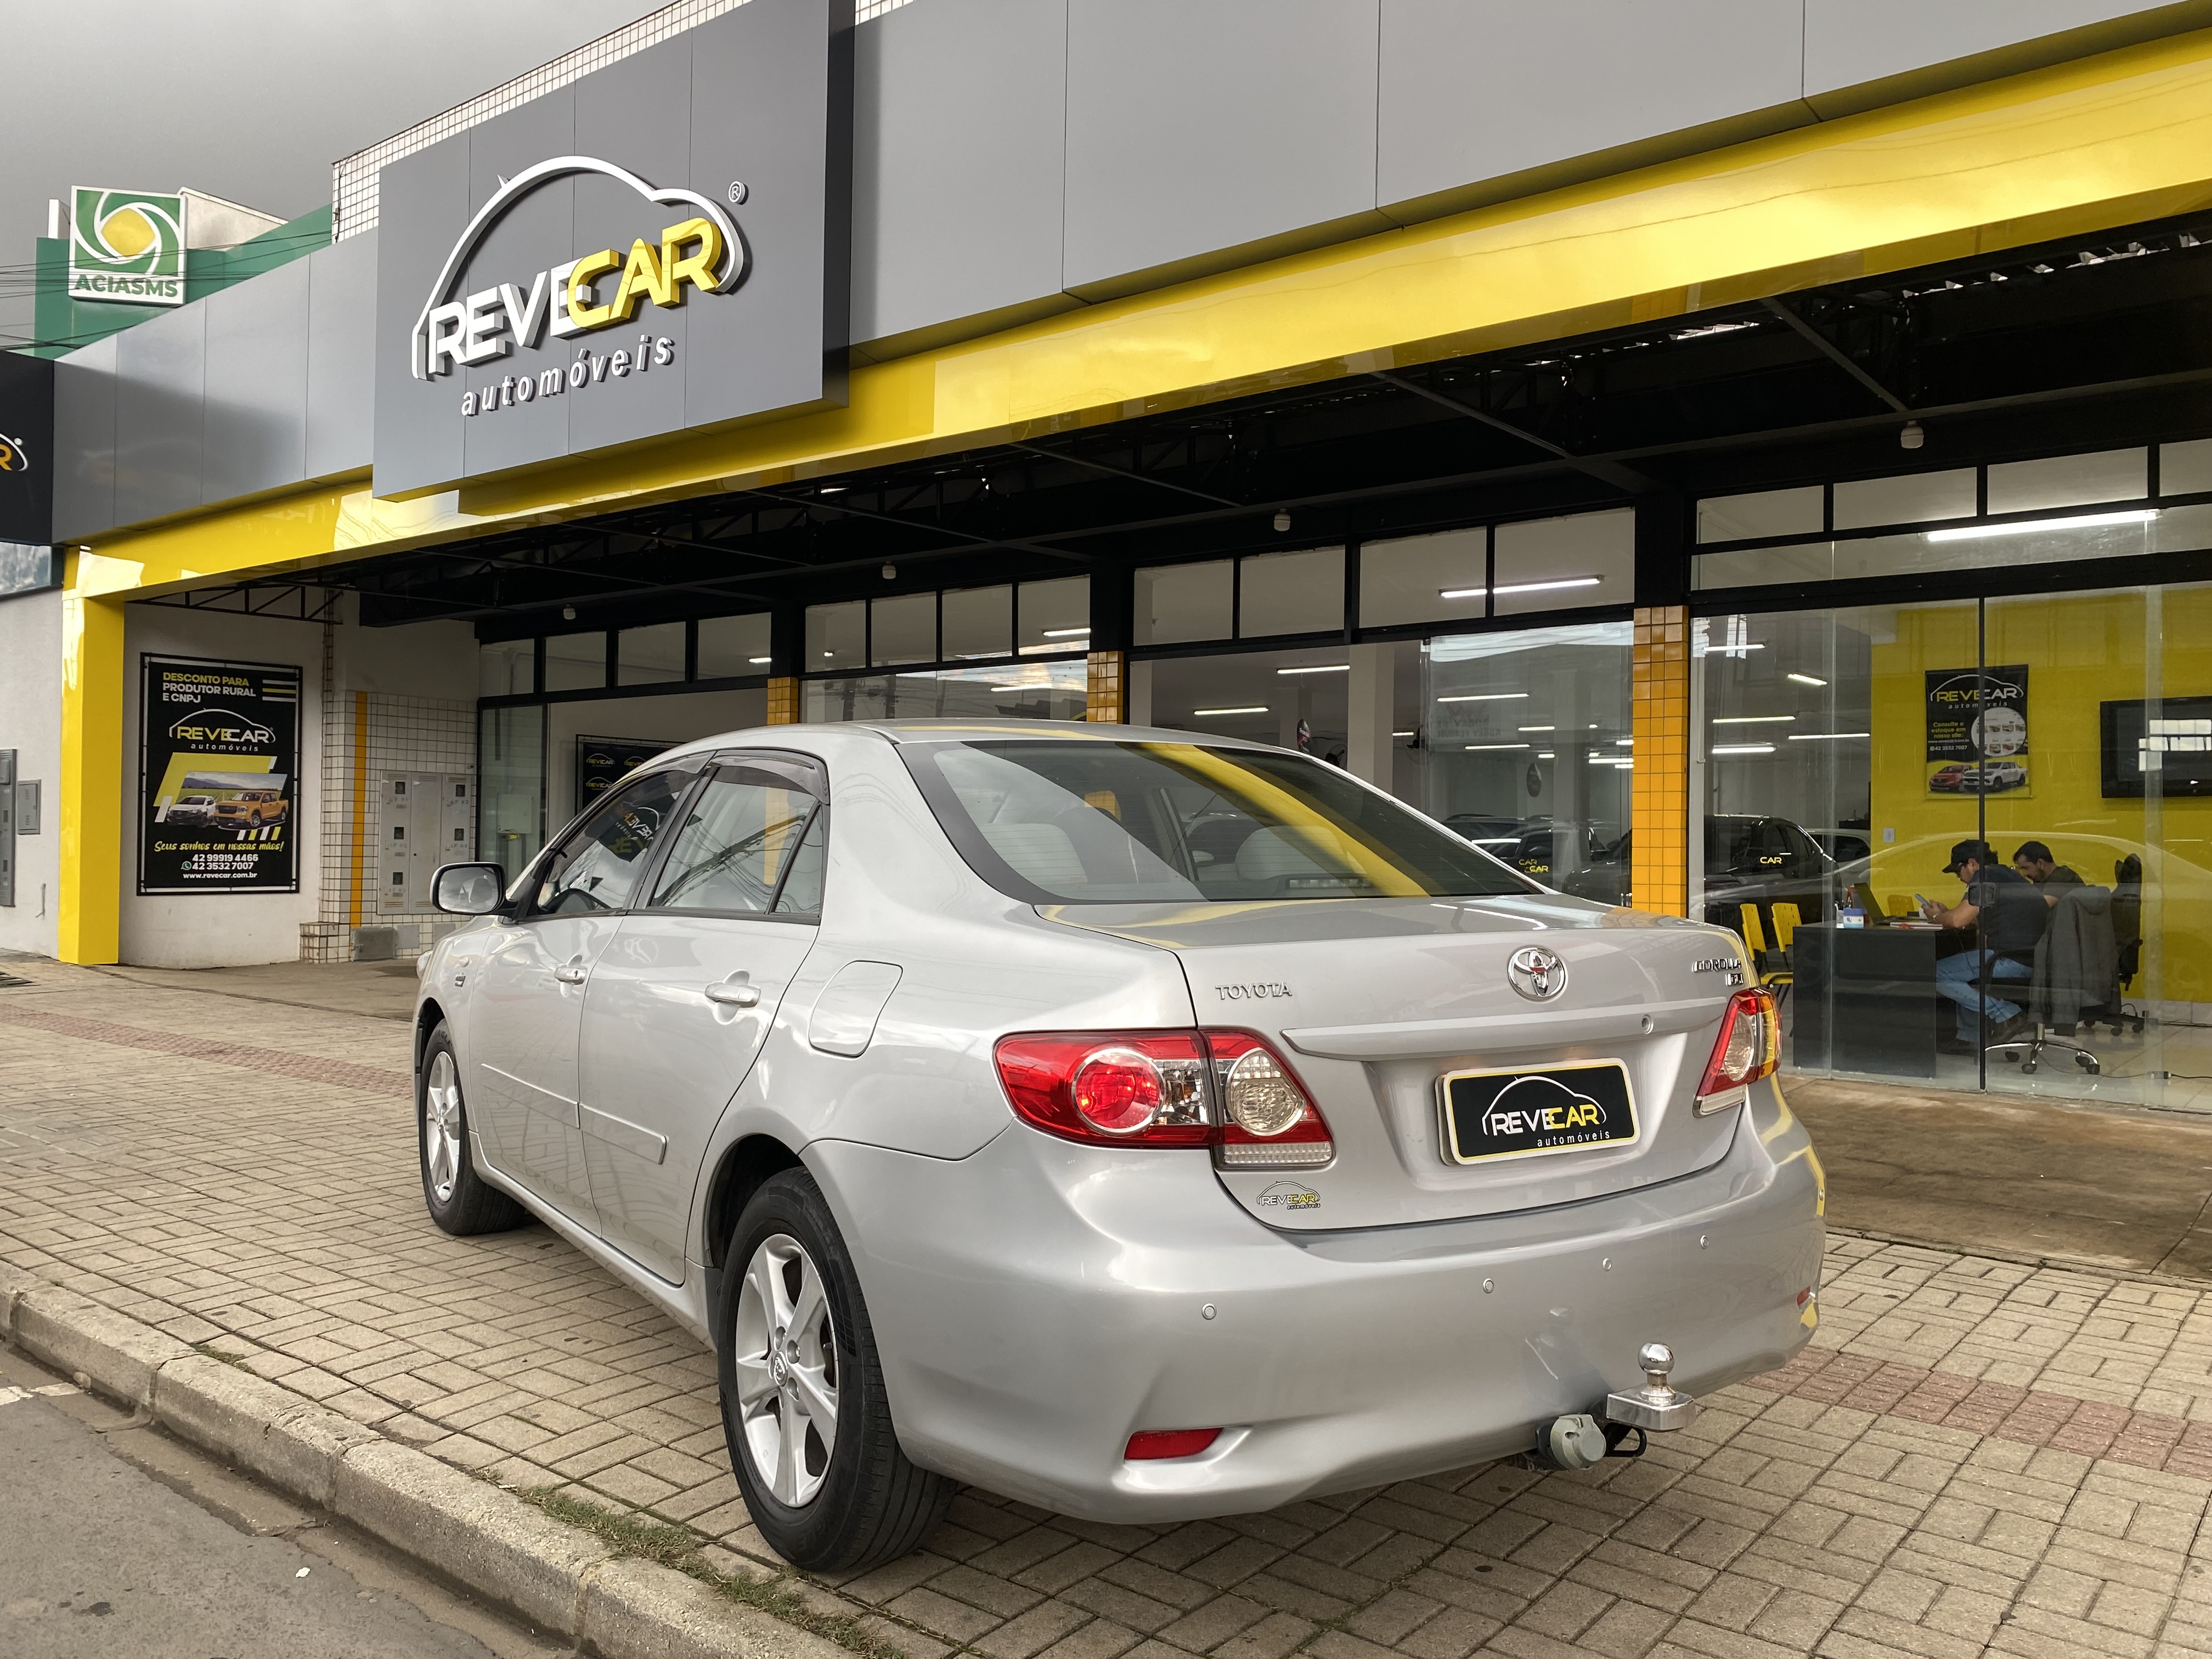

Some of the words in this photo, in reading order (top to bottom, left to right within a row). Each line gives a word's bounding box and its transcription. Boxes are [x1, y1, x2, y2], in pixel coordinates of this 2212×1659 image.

[74, 274, 178, 297] ACIASMS
[429, 217, 722, 375] REVECAR
[460, 335, 675, 416] automóveis
[163, 672, 220, 684] DESCONTO
[222, 677, 249, 686] PARA
[162, 682, 221, 694] PRODUTOR
[223, 687, 256, 697] RURAL
[162, 693, 169, 701] E
[171, 693, 201, 703] CNPJ
[1948, 701, 2008, 709] automveis
[177, 726, 269, 743] REVECAR
[190, 743, 258, 752] automóveis
[154, 841, 177, 852] Seus
[179, 841, 211, 850] sonhos
[1215, 981, 1293, 1000] TOYOTA
[1490, 1104, 1600, 1136] REVECAR
[1537, 1130, 1611, 1147] automóveis
[1261, 1193, 1316, 1206] REVECAR
